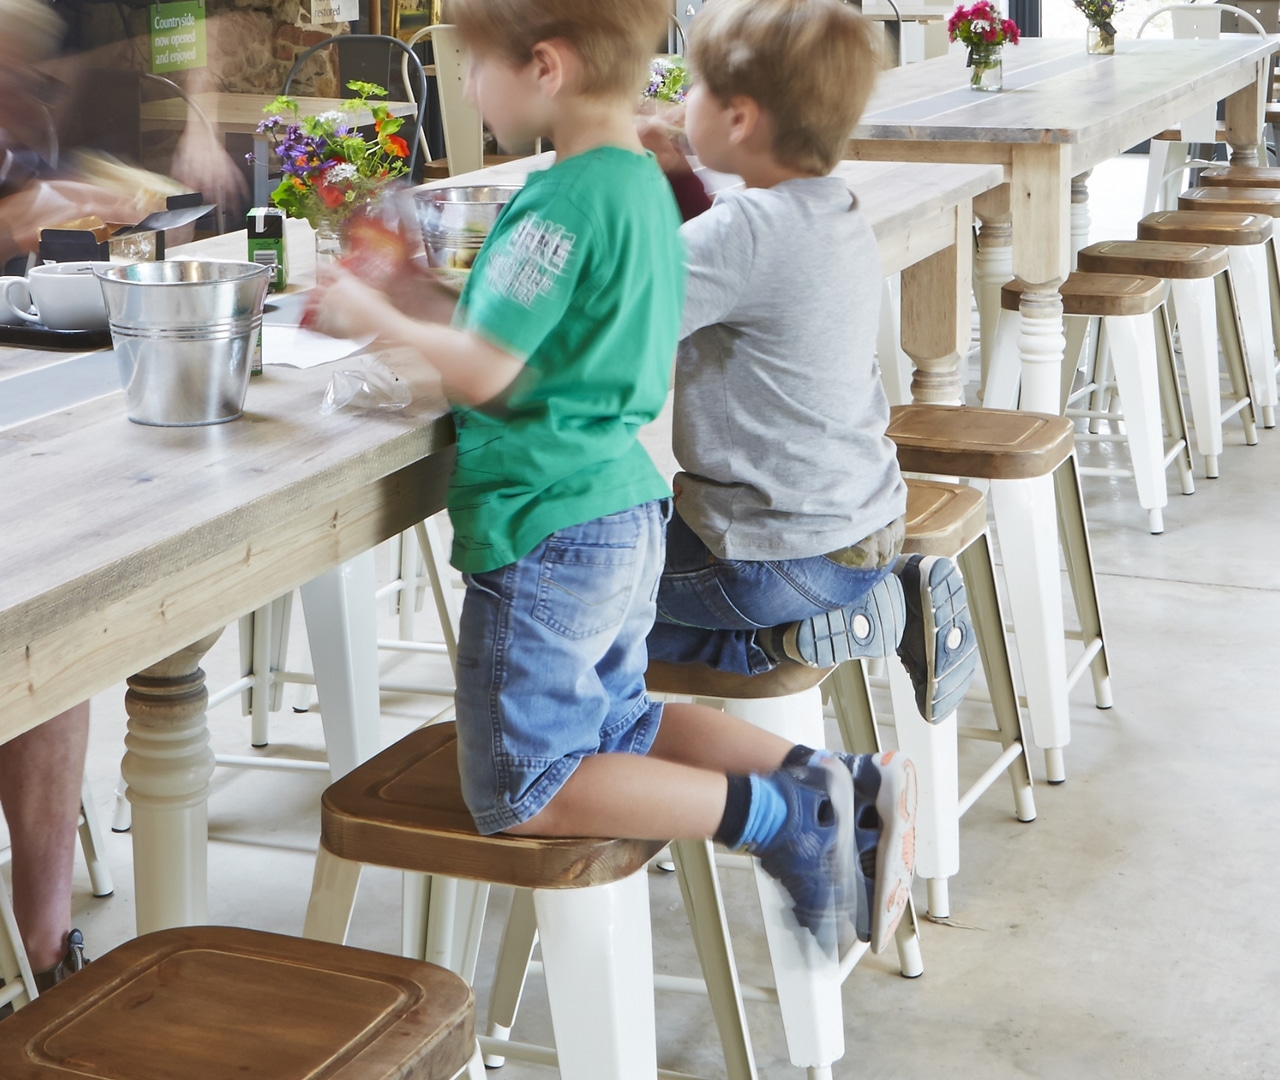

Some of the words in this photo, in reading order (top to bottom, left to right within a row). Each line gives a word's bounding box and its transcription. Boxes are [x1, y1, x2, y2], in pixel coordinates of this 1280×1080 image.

[315, 6, 340, 18] restored
[154, 13, 195, 30] Countryside
[155, 37, 169, 47] now
[171, 29, 196, 47] opened
[155, 51, 169, 65] and
[170, 48, 196, 63] enjoyed
